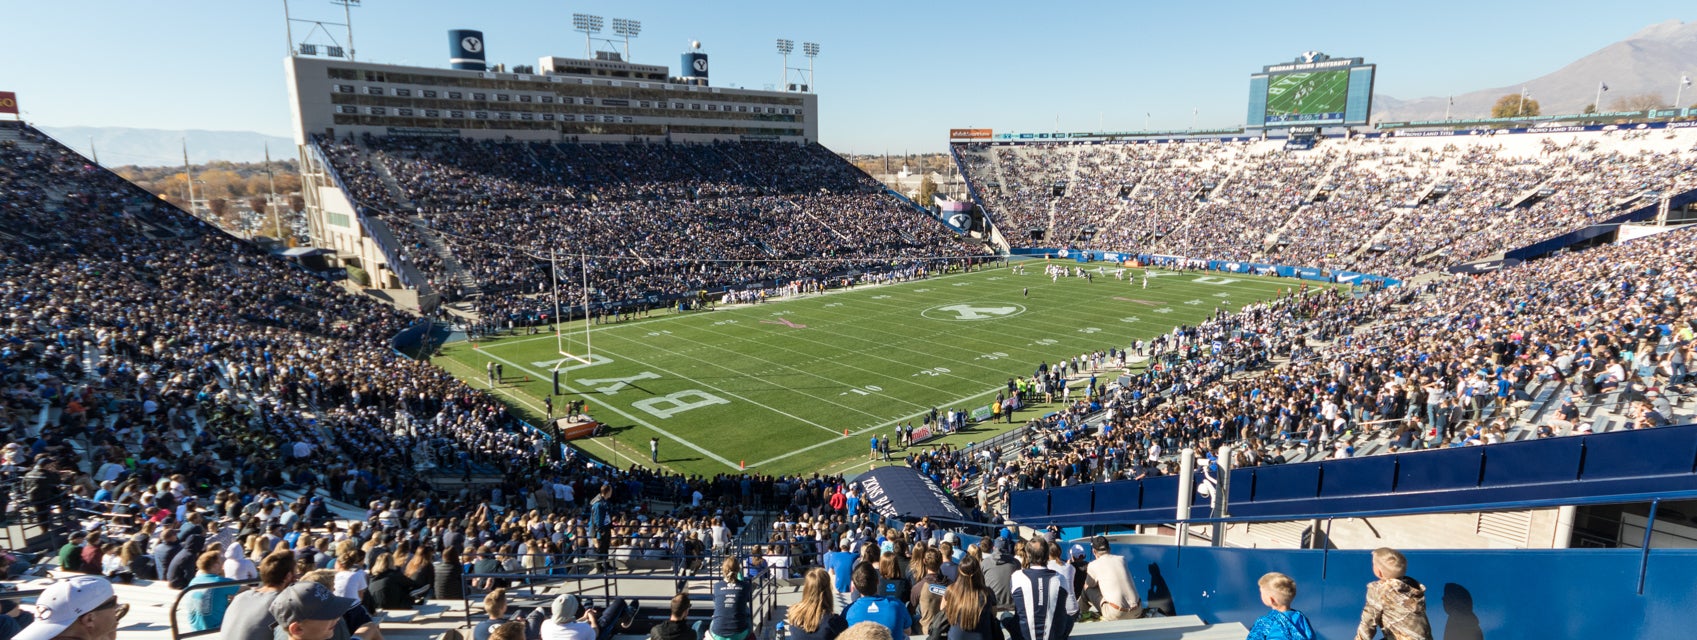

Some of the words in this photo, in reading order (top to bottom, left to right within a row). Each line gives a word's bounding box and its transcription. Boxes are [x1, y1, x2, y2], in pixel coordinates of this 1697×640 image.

[920, 367, 951, 377] 20
[850, 384, 883, 396] 10
[862, 475, 884, 499] ZIONS
